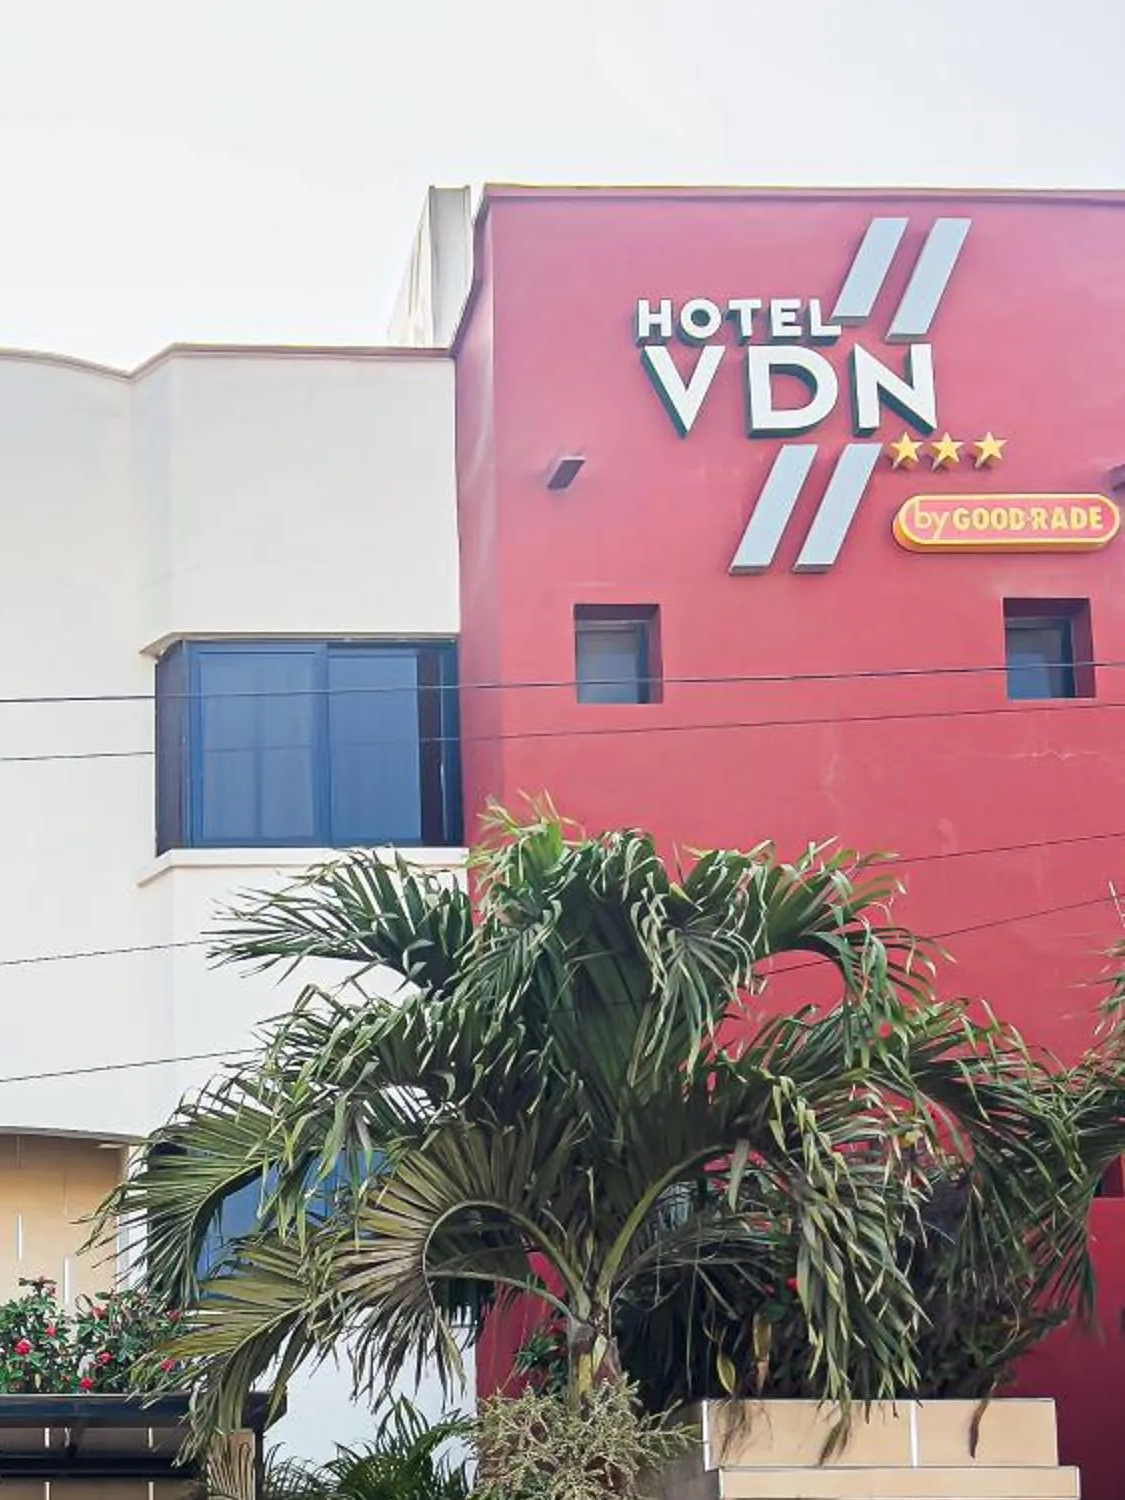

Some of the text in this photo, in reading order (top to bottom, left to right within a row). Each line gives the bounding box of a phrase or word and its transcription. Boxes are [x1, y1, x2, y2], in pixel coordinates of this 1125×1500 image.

[636, 298, 842, 344] HOTEL
[641, 343, 938, 438] VDN
[914, 500, 949, 539] by
